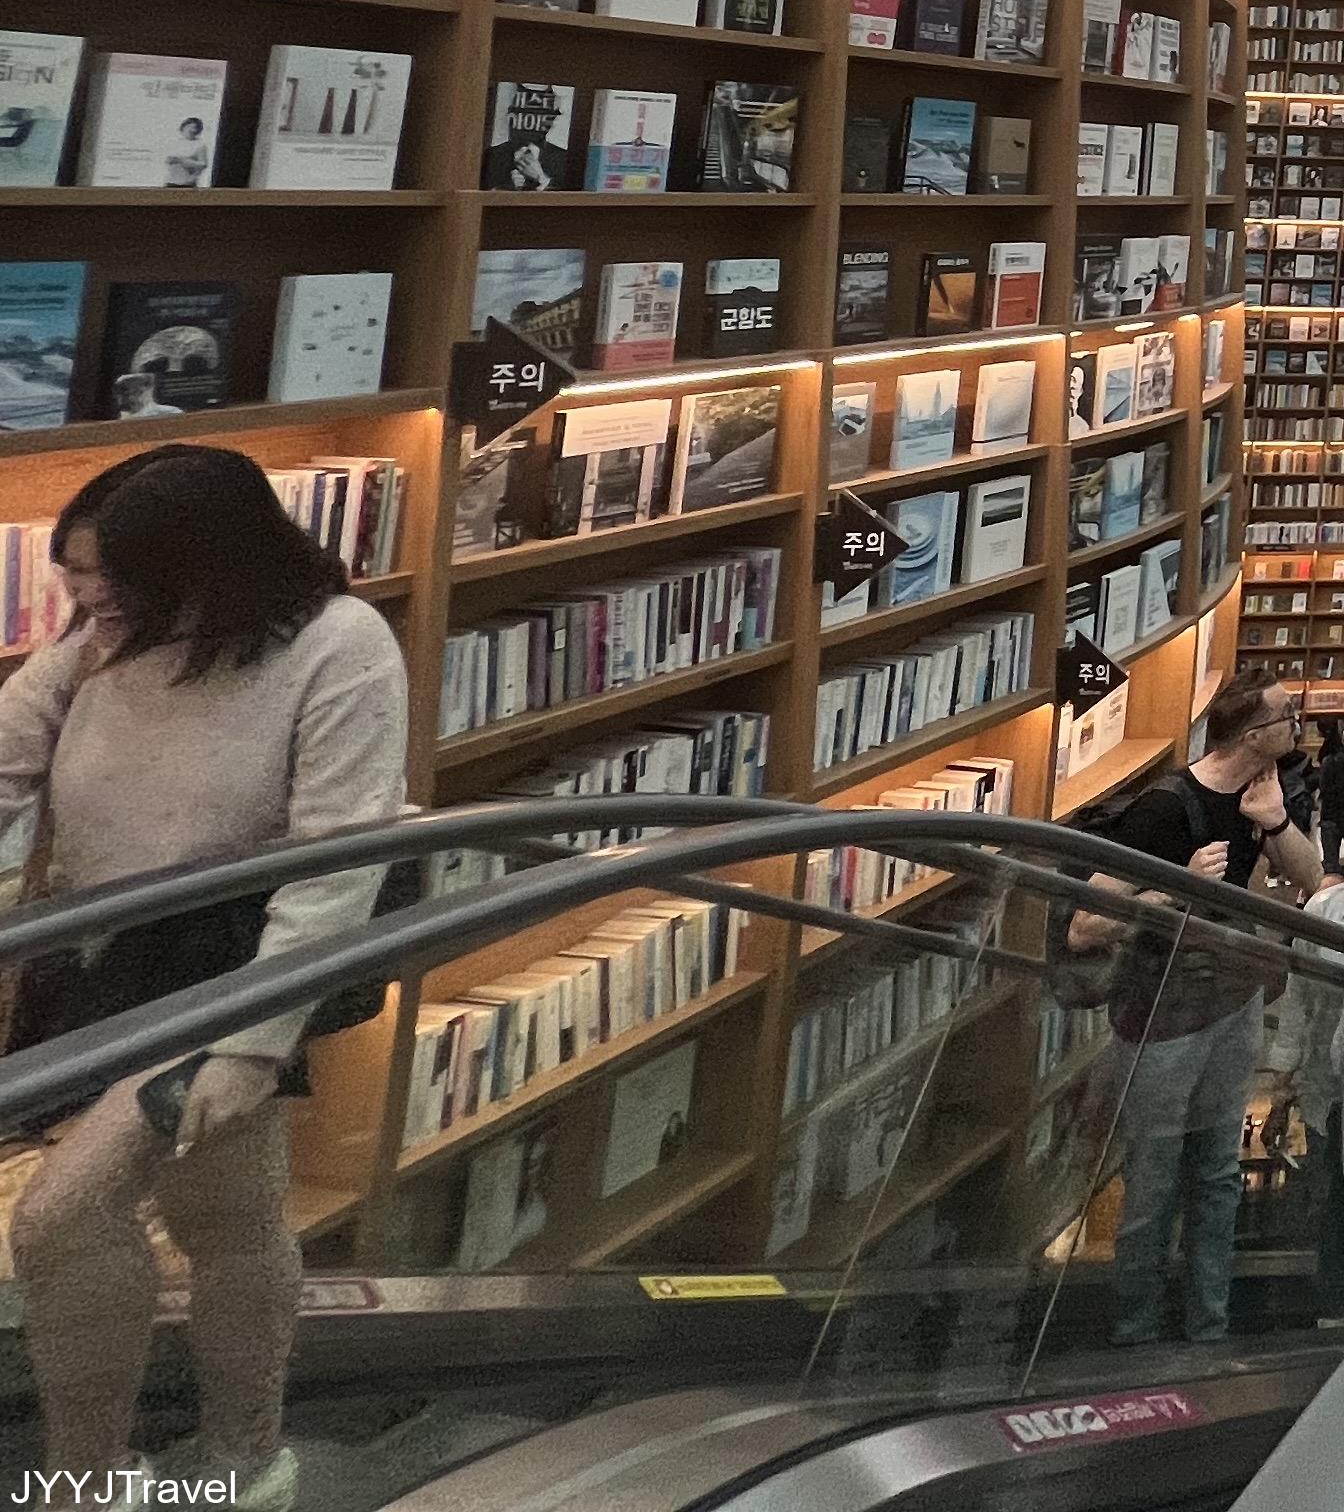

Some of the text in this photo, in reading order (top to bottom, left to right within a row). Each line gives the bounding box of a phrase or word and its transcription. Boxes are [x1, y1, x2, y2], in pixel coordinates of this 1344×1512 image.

[720, 306, 774, 332] 군함도
[489, 361, 545, 394] 주의
[841, 530, 886, 557] 주의
[1078, 663, 1110, 685] 주의
